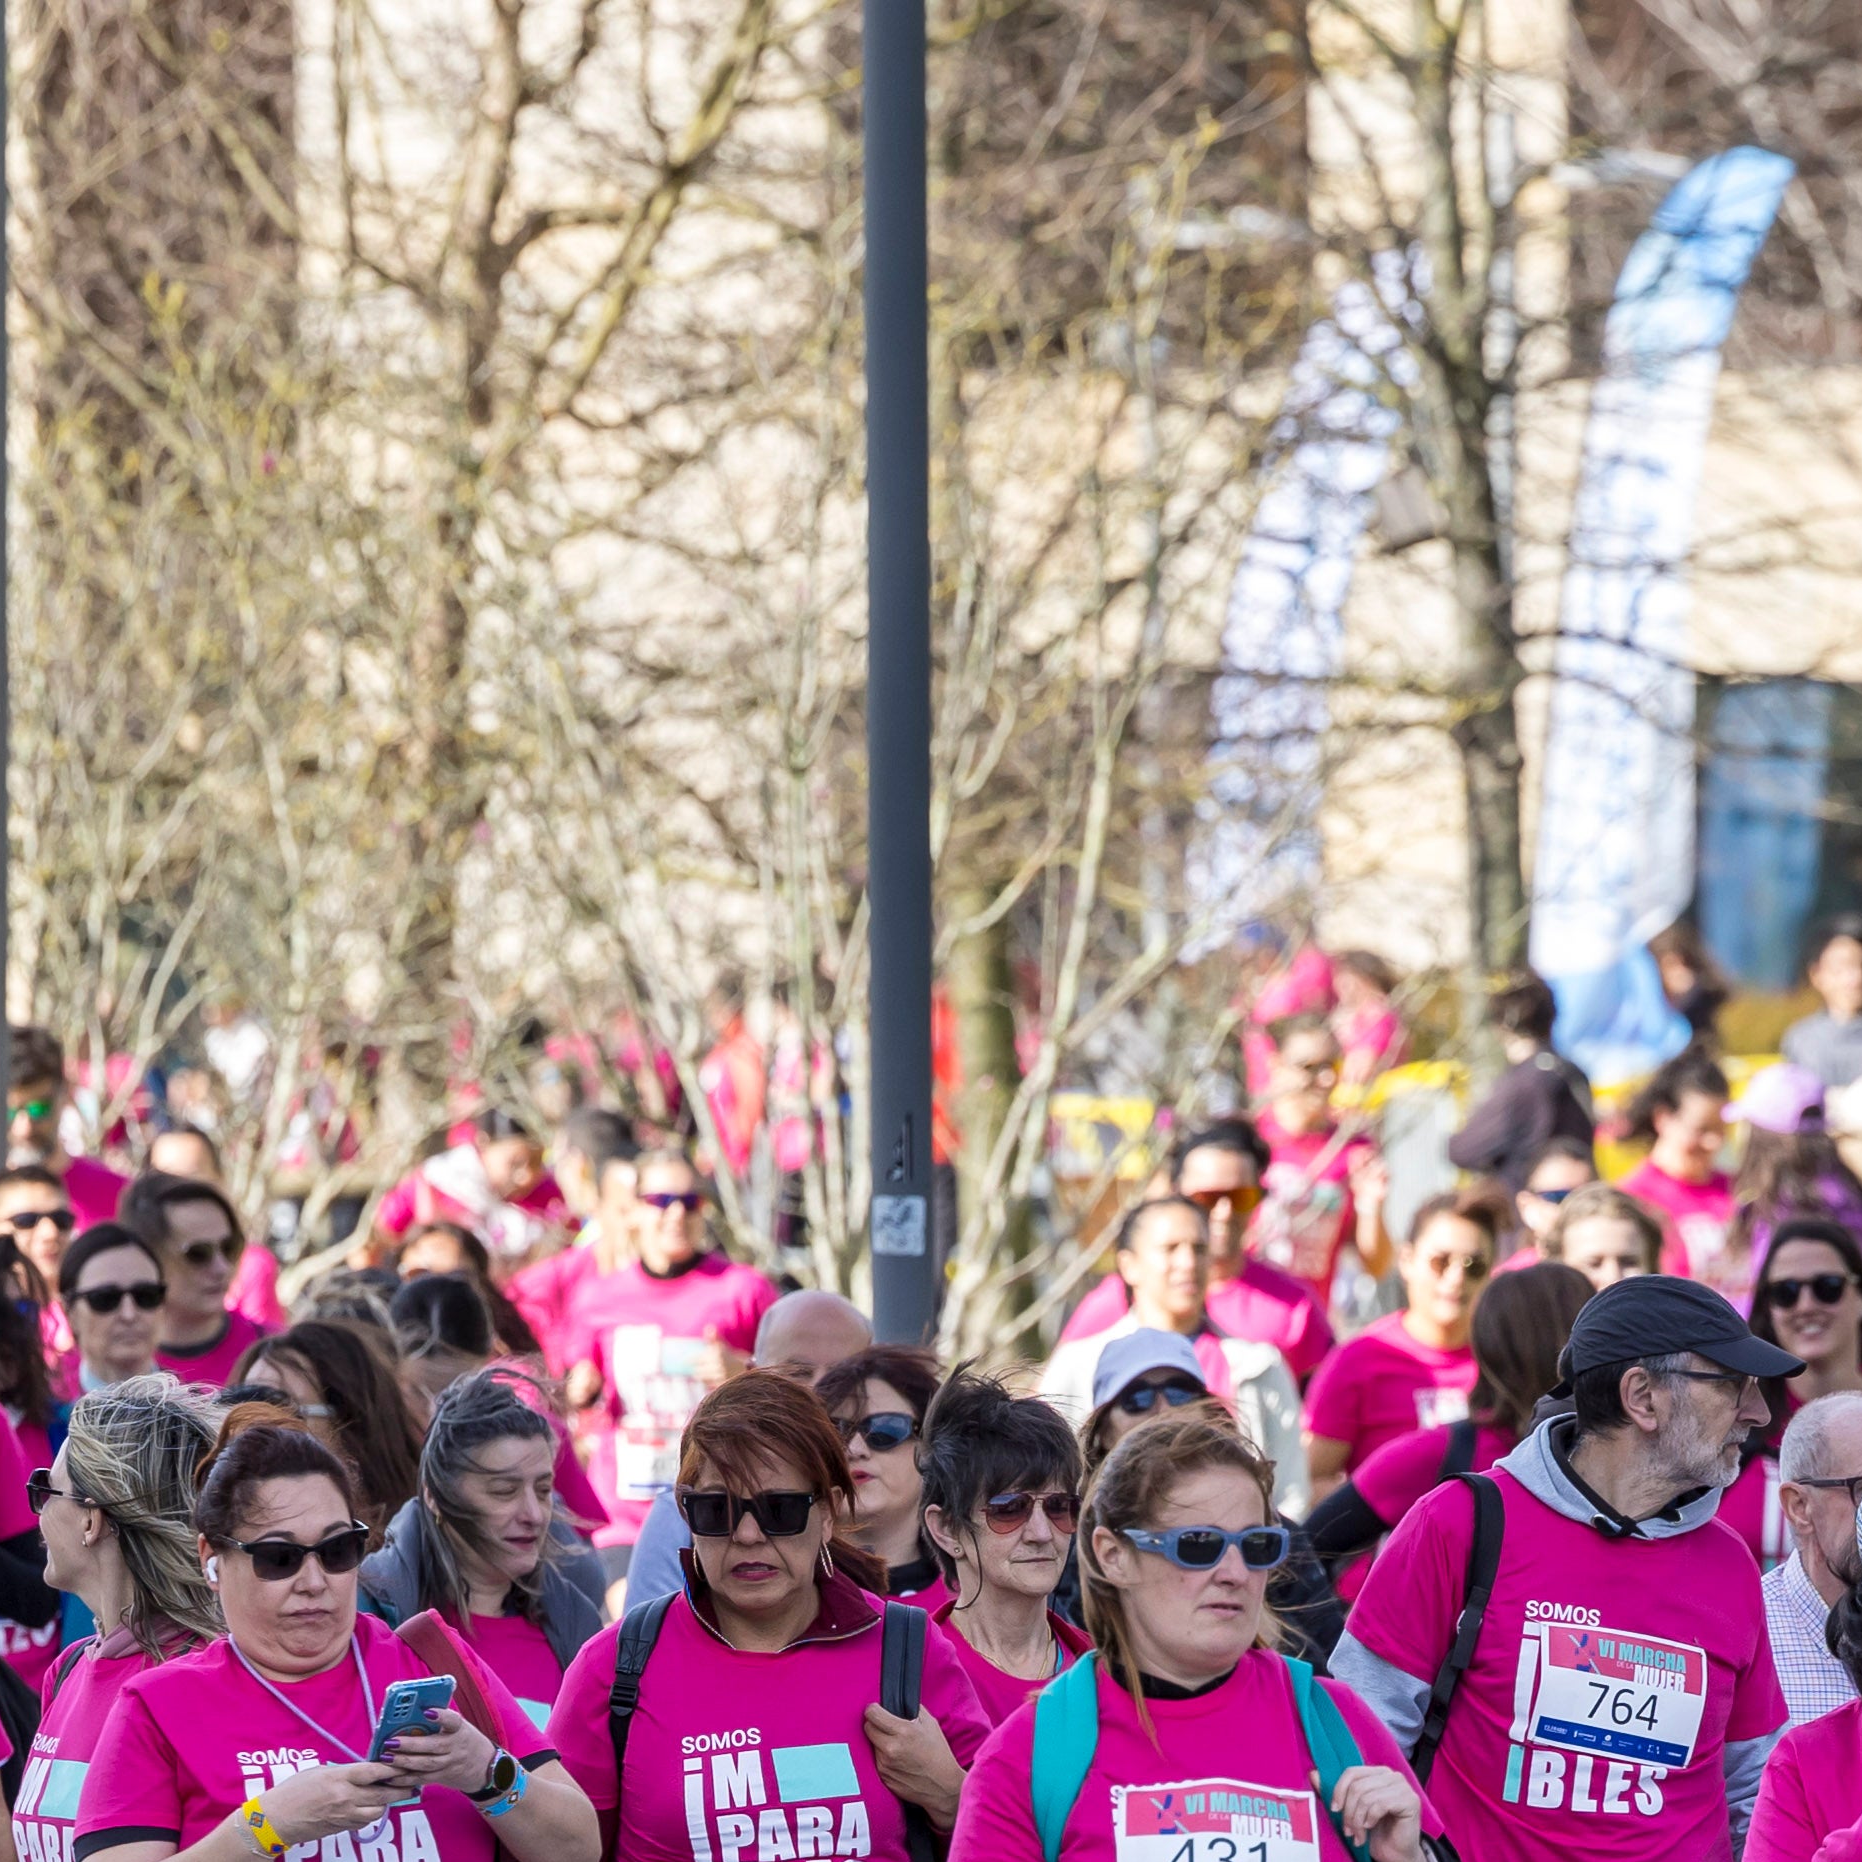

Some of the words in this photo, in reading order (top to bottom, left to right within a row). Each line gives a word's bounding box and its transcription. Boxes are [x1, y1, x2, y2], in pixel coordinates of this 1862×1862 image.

[1525, 1600, 1601, 1627] SOMOS
[1598, 1638, 1615, 1658] VI
[1618, 1642, 1687, 1674] MARCHA
[1634, 1665, 1686, 1693] MUJER
[1587, 1682, 1659, 1731] 764
[681, 1727, 761, 1754] SOMOS
[237, 1747, 318, 1766] SOMOS
[1184, 1793, 1205, 1815] VI
[1210, 1792, 1290, 1820] MARCHA
[716, 1801, 871, 1862] PARA
[1231, 1814, 1293, 1840] MUJER
